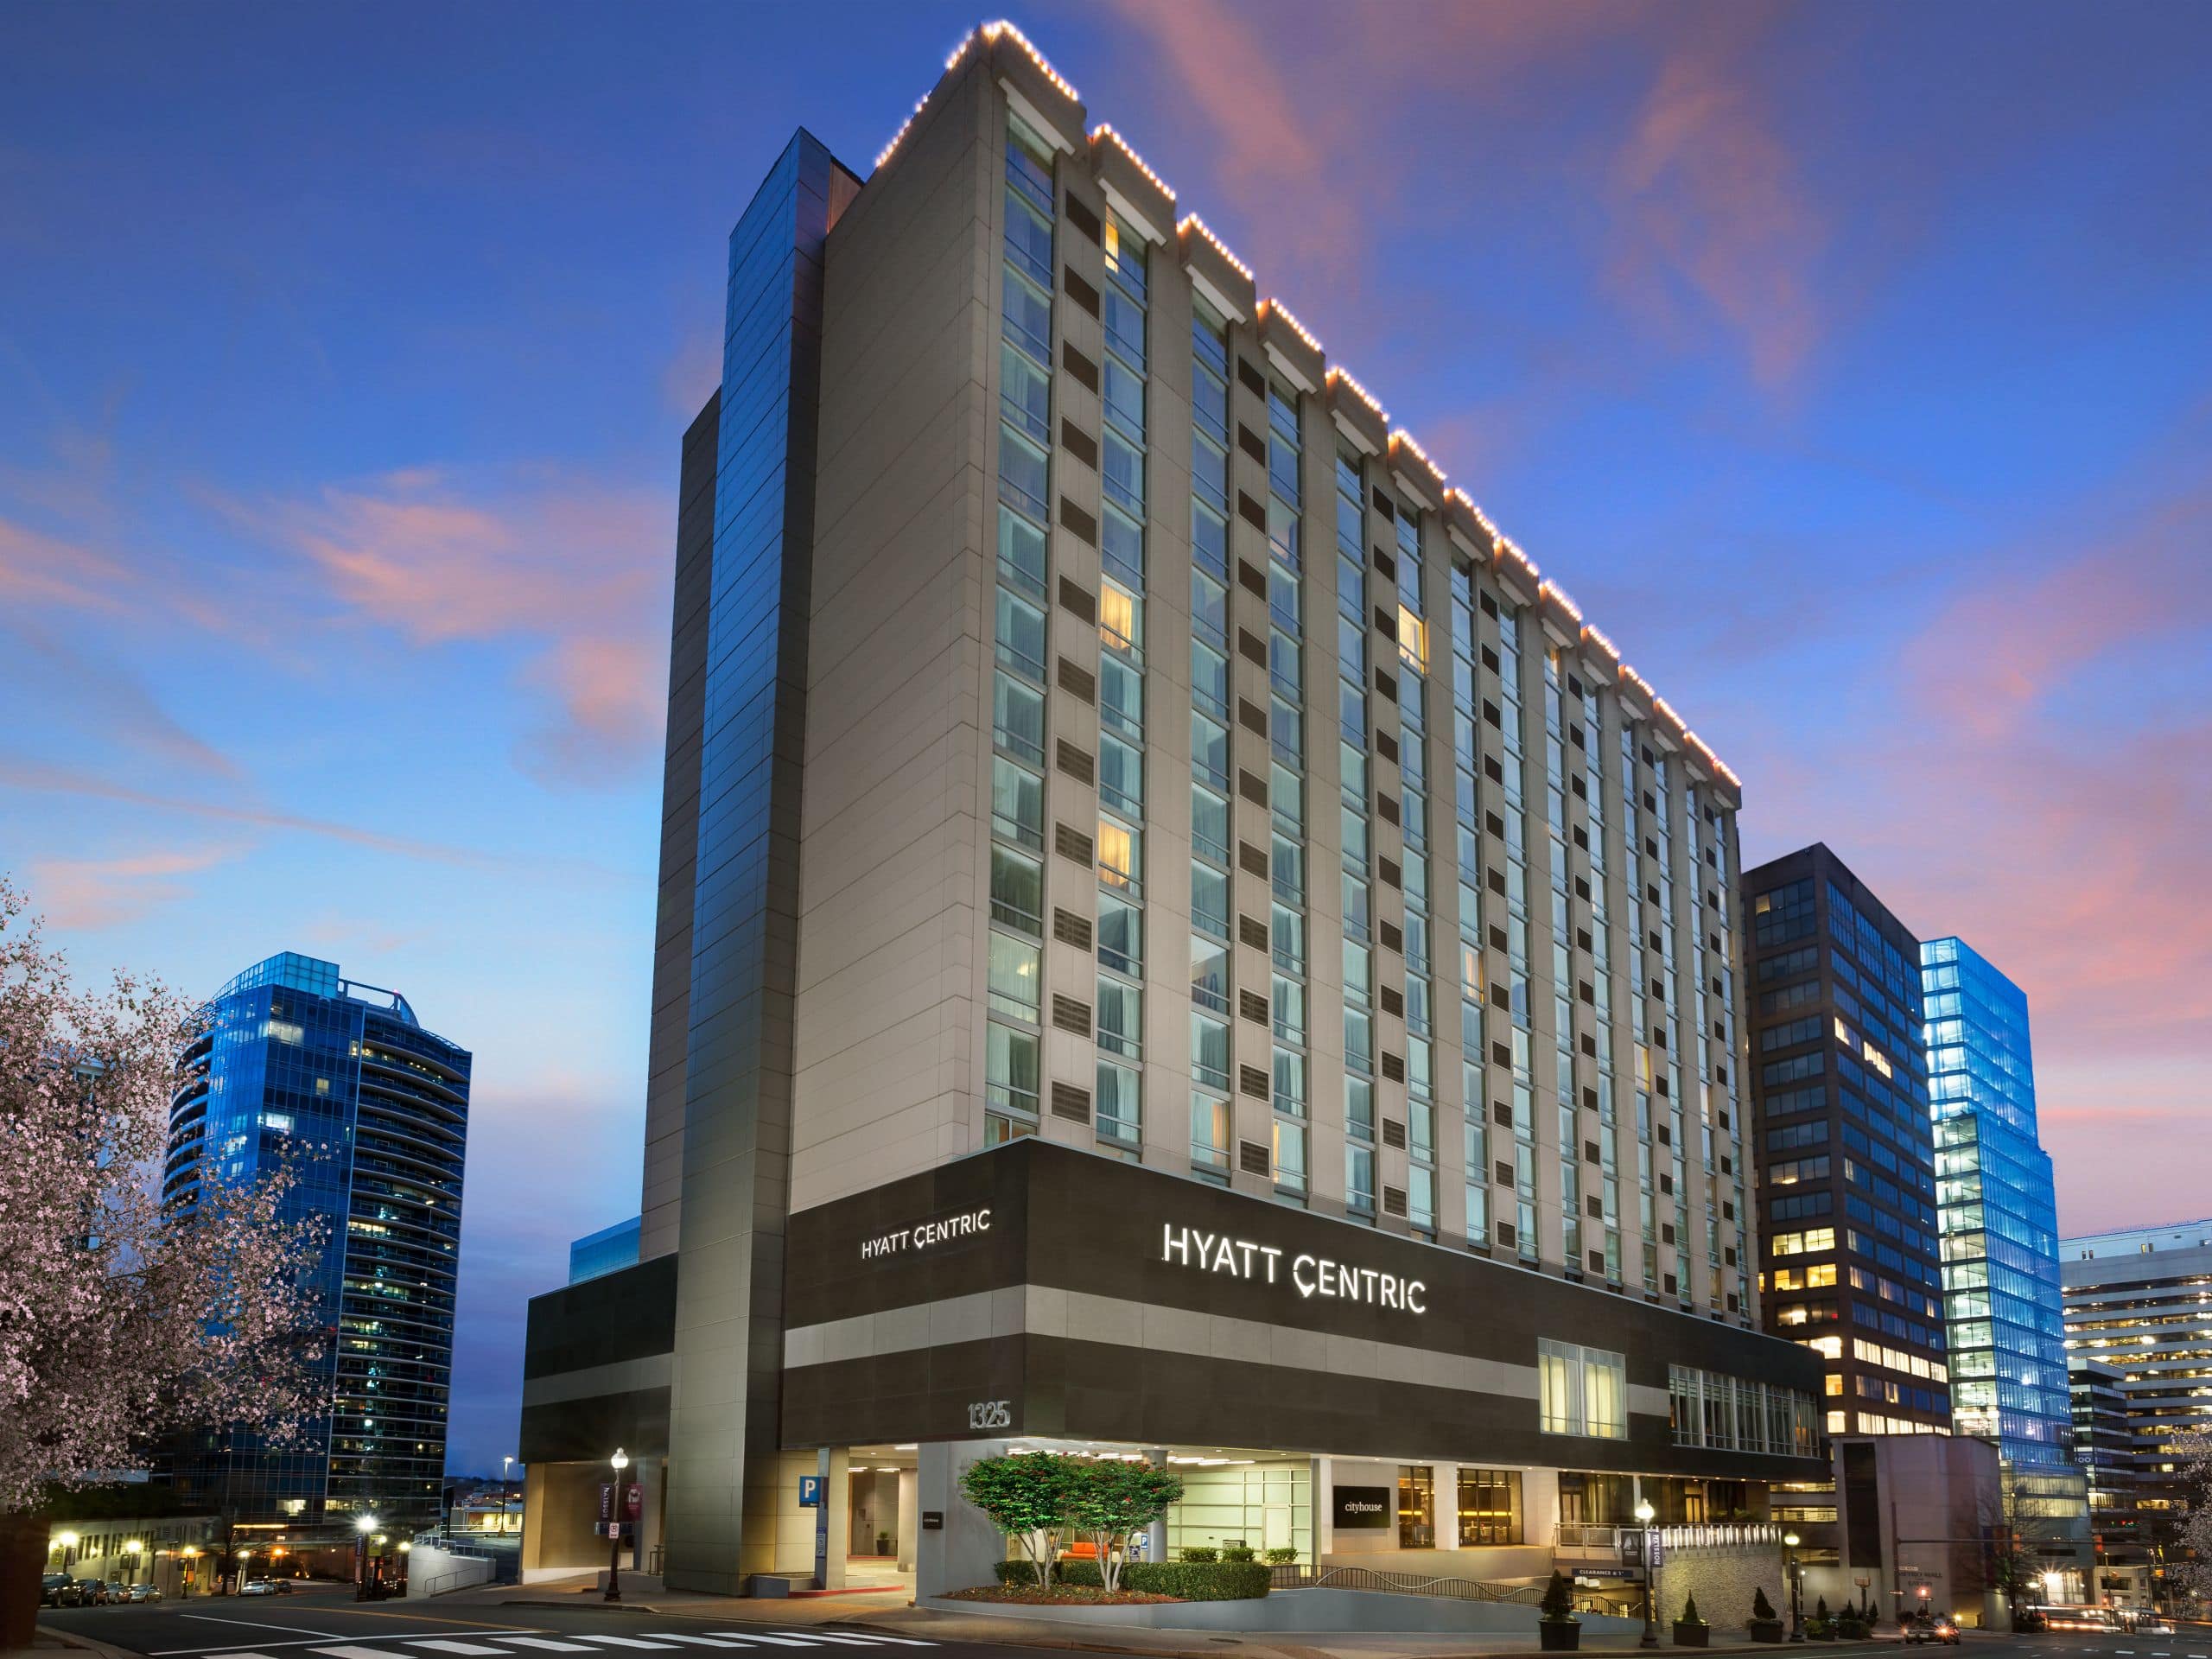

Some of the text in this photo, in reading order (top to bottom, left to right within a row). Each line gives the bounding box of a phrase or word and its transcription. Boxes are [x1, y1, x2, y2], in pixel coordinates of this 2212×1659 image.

[861, 1210, 991, 1260] HYATT CENTRIC
[1163, 1223, 1427, 1314] HYATT CENTRIC
[968, 1400, 1011, 1429] 1325
[804, 1478, 817, 1498] P
[1344, 1501, 1382, 1515] cityhouse
